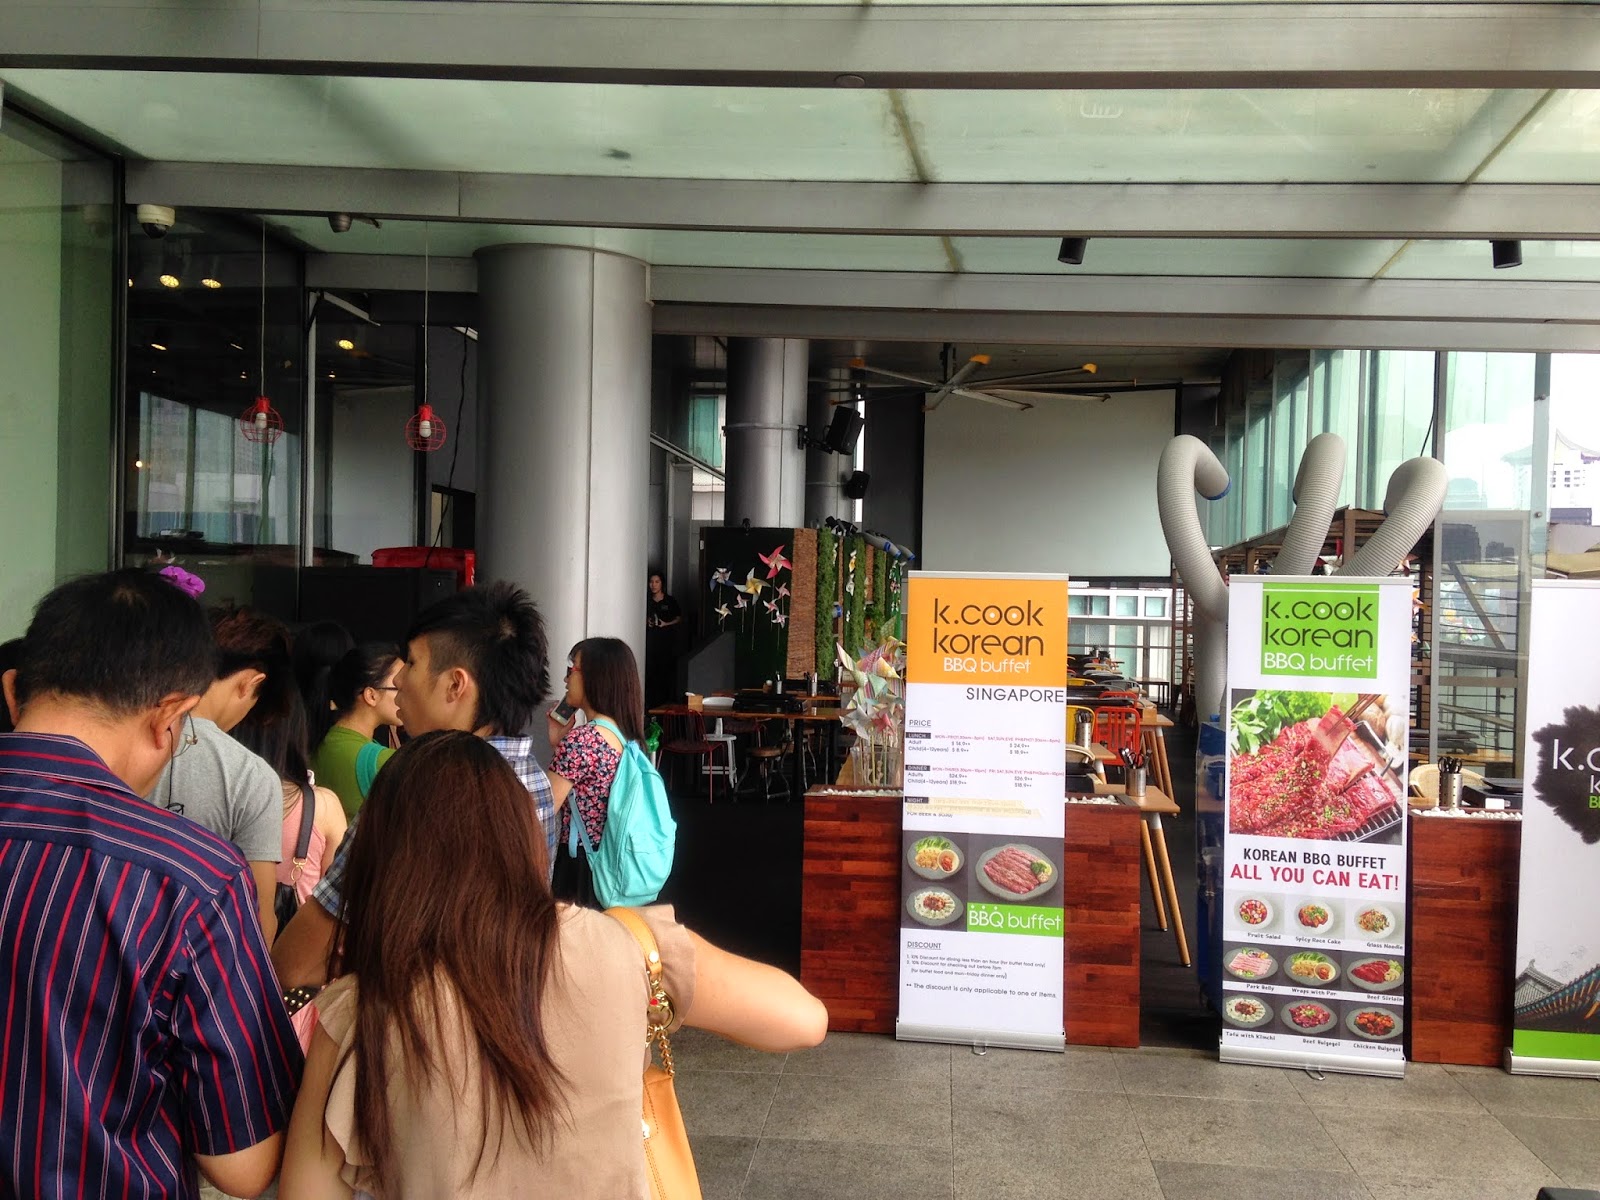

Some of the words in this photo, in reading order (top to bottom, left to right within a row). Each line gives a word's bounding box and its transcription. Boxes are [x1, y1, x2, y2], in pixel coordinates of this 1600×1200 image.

[934, 597, 1044, 626] k.cook
[1265, 595, 1373, 621] k.cook
[933, 627, 1044, 656] korean
[1264, 622, 1373, 648] korean
[943, 657, 977, 673] BBQ
[980, 658, 1031, 674] buffet
[1264, 652, 1305, 671] BBQ
[1310, 654, 1373, 672] buffet
[966, 687, 1064, 703] SINGAPORE
[909, 719, 932, 727] PRICE
[1243, 848, 1296, 863] KOREAN
[1303, 852, 1331, 866] BBQ
[1337, 854, 1386, 870] BUFFET
[1230, 864, 1262, 881] ALL
[1270, 866, 1305, 883] YOU
[1312, 869, 1350, 887] CAN
[1358, 873, 1399, 891] EAT!
[969, 910, 1004, 929] BBQ
[1008, 912, 1061, 931] buffet
[907, 941, 942, 949] DISCOUNT
